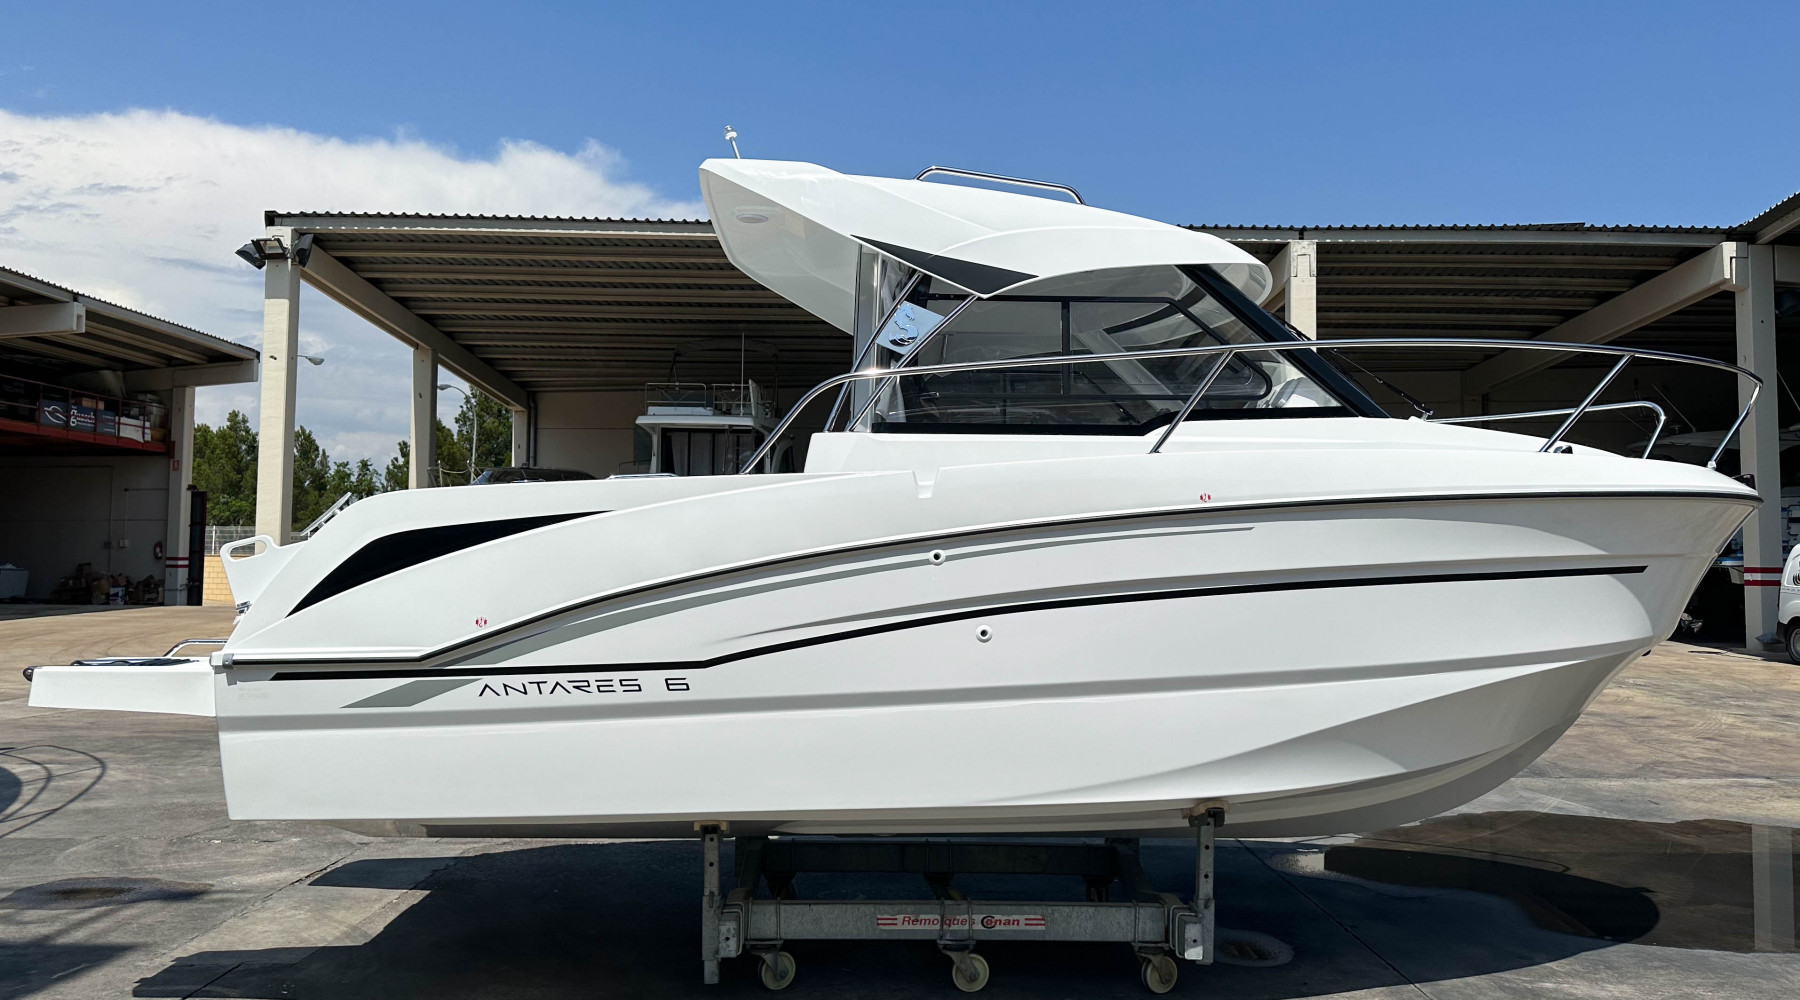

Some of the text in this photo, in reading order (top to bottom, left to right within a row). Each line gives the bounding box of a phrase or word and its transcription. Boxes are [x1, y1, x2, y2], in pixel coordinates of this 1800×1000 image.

[478, 677, 690, 697] ANTARES 6
[902, 915, 976, 928] Remoques
